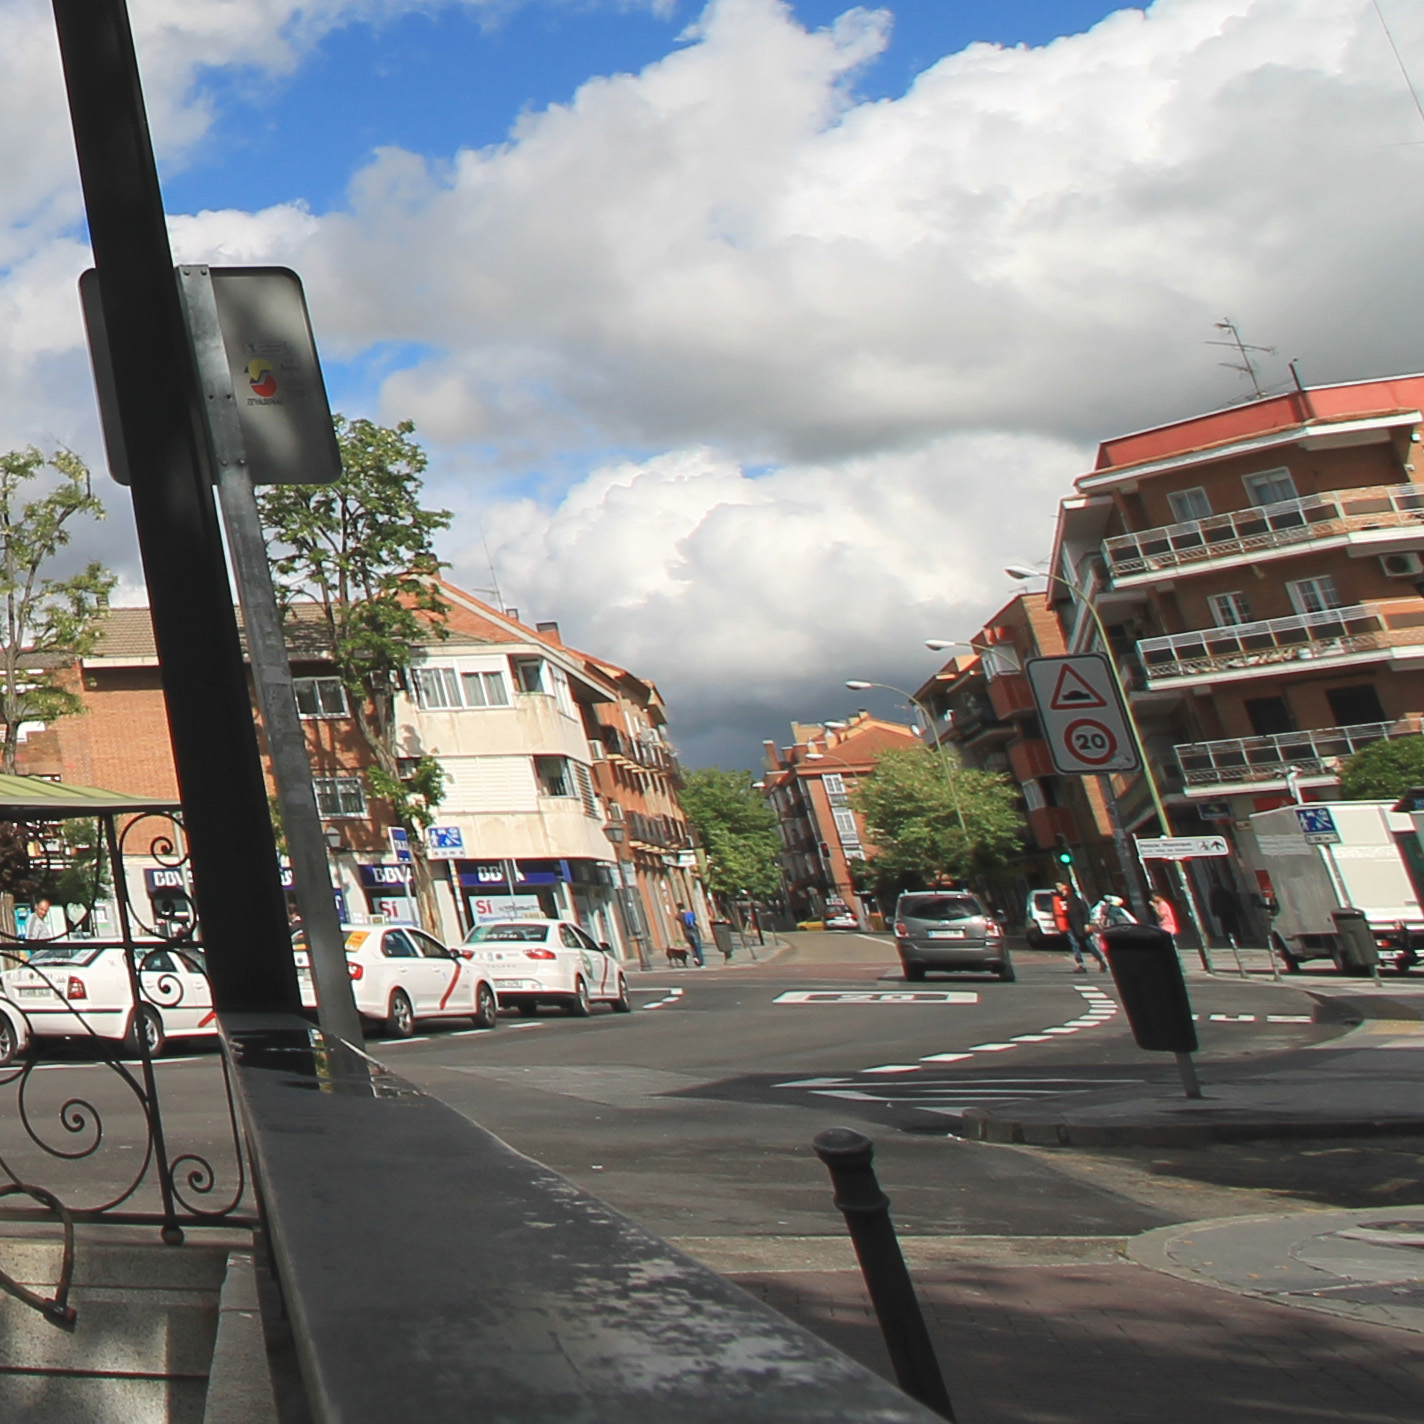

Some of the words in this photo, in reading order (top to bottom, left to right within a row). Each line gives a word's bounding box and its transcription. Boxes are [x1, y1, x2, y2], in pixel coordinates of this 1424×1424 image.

[1075, 733, 1106, 750] 20
[379, 901, 399, 919] Sí
[475, 899, 494, 915] Sí
